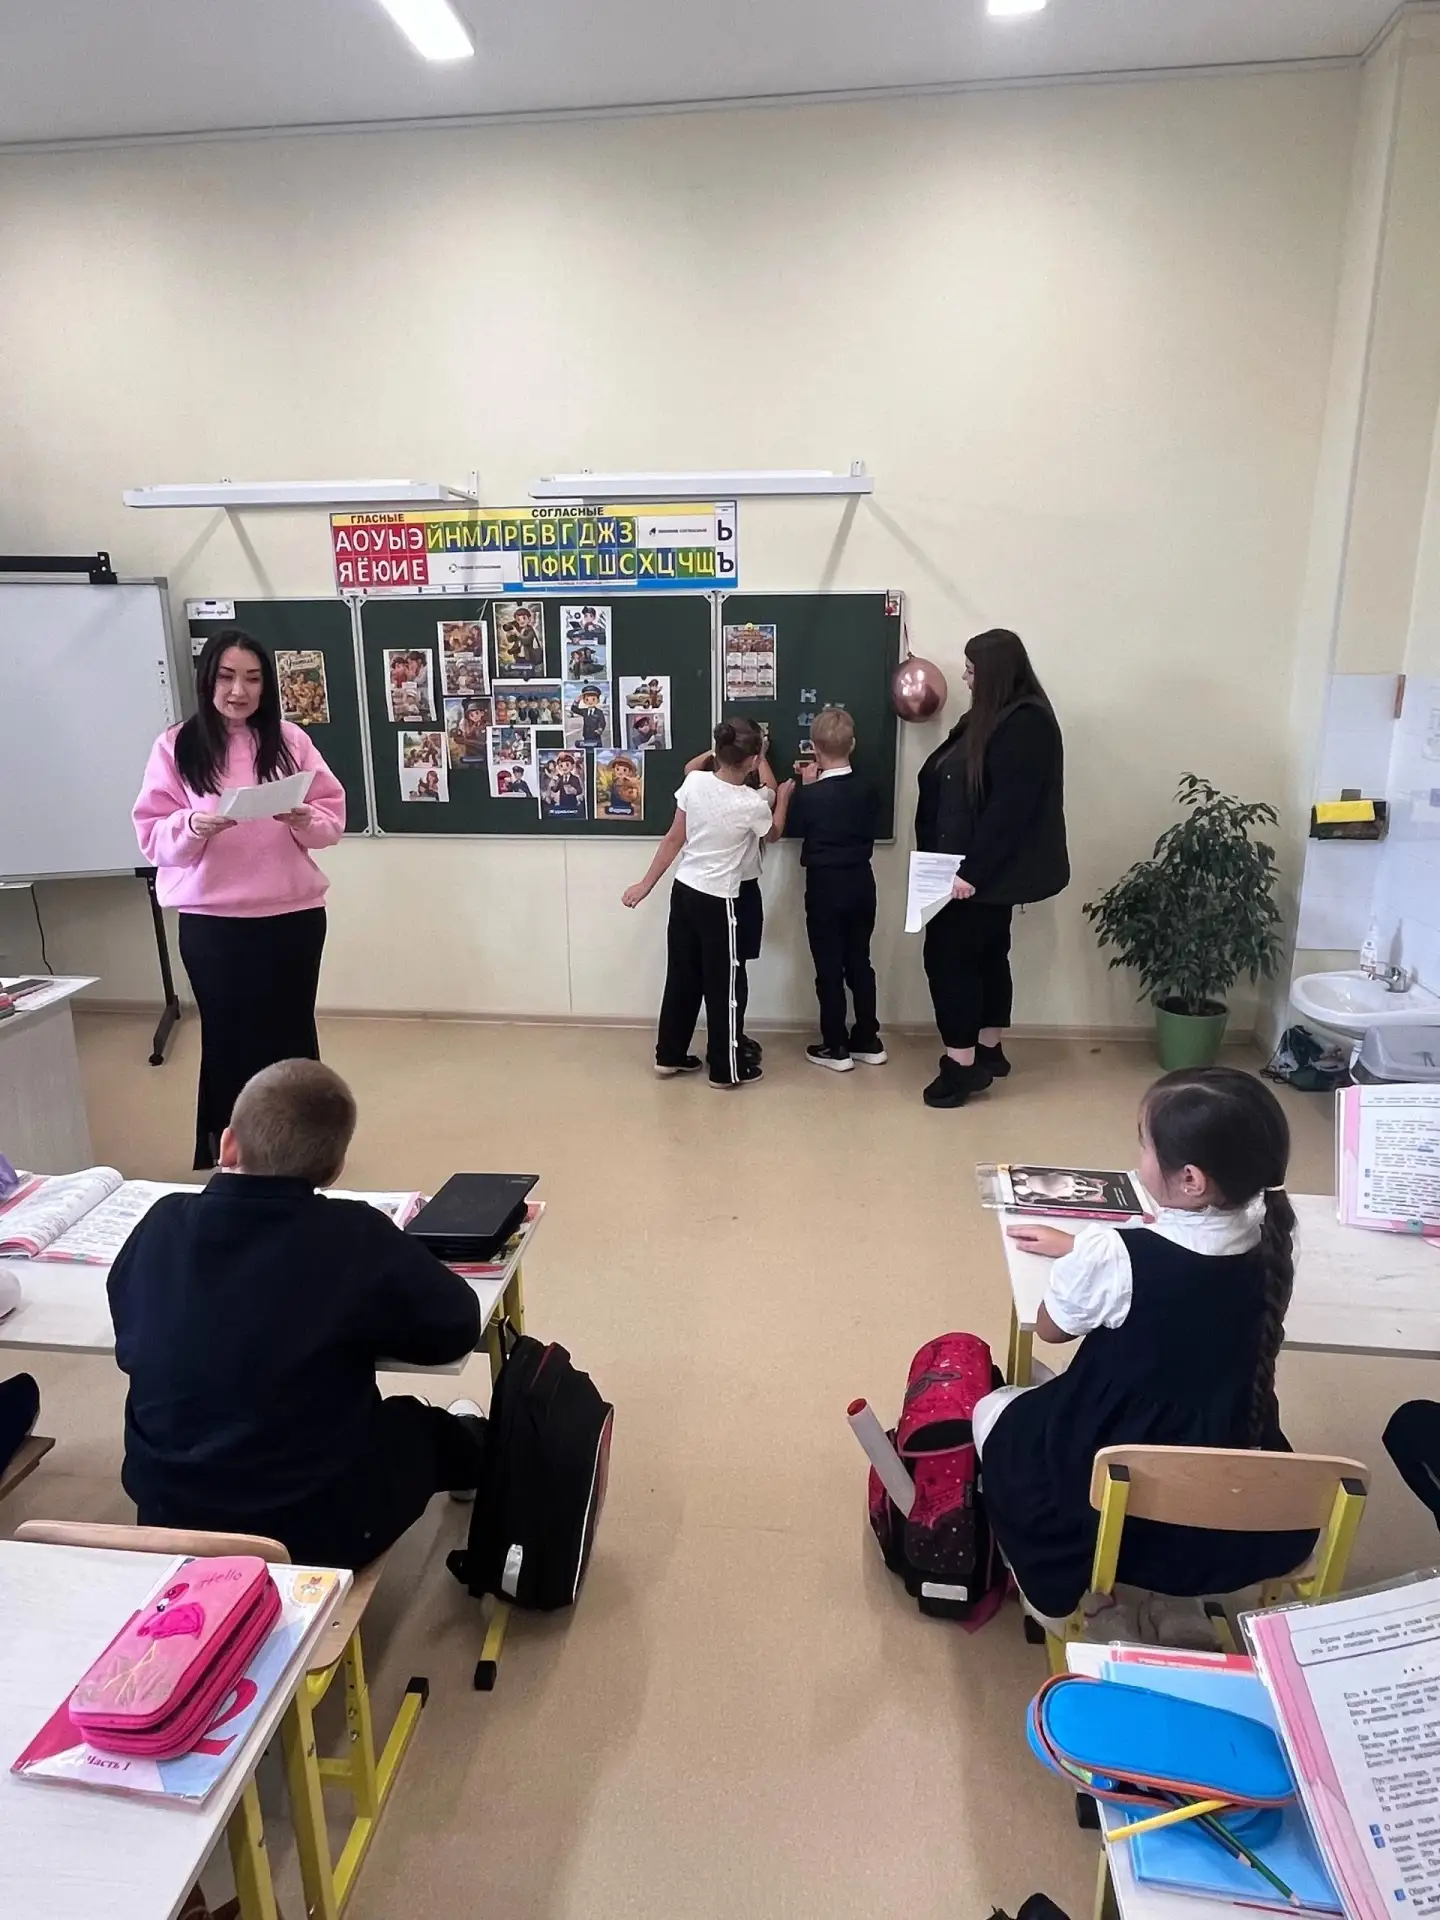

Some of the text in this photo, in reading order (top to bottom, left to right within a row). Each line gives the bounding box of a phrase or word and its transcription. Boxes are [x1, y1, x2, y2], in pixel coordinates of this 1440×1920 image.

[350, 513, 405, 524] ГЛАСНЫЕ
[531, 506, 604, 518] СОГЛАСНЫЕ
[202, 1568, 243, 1587] Hello
[86, 1755, 119, 1770] Часть
